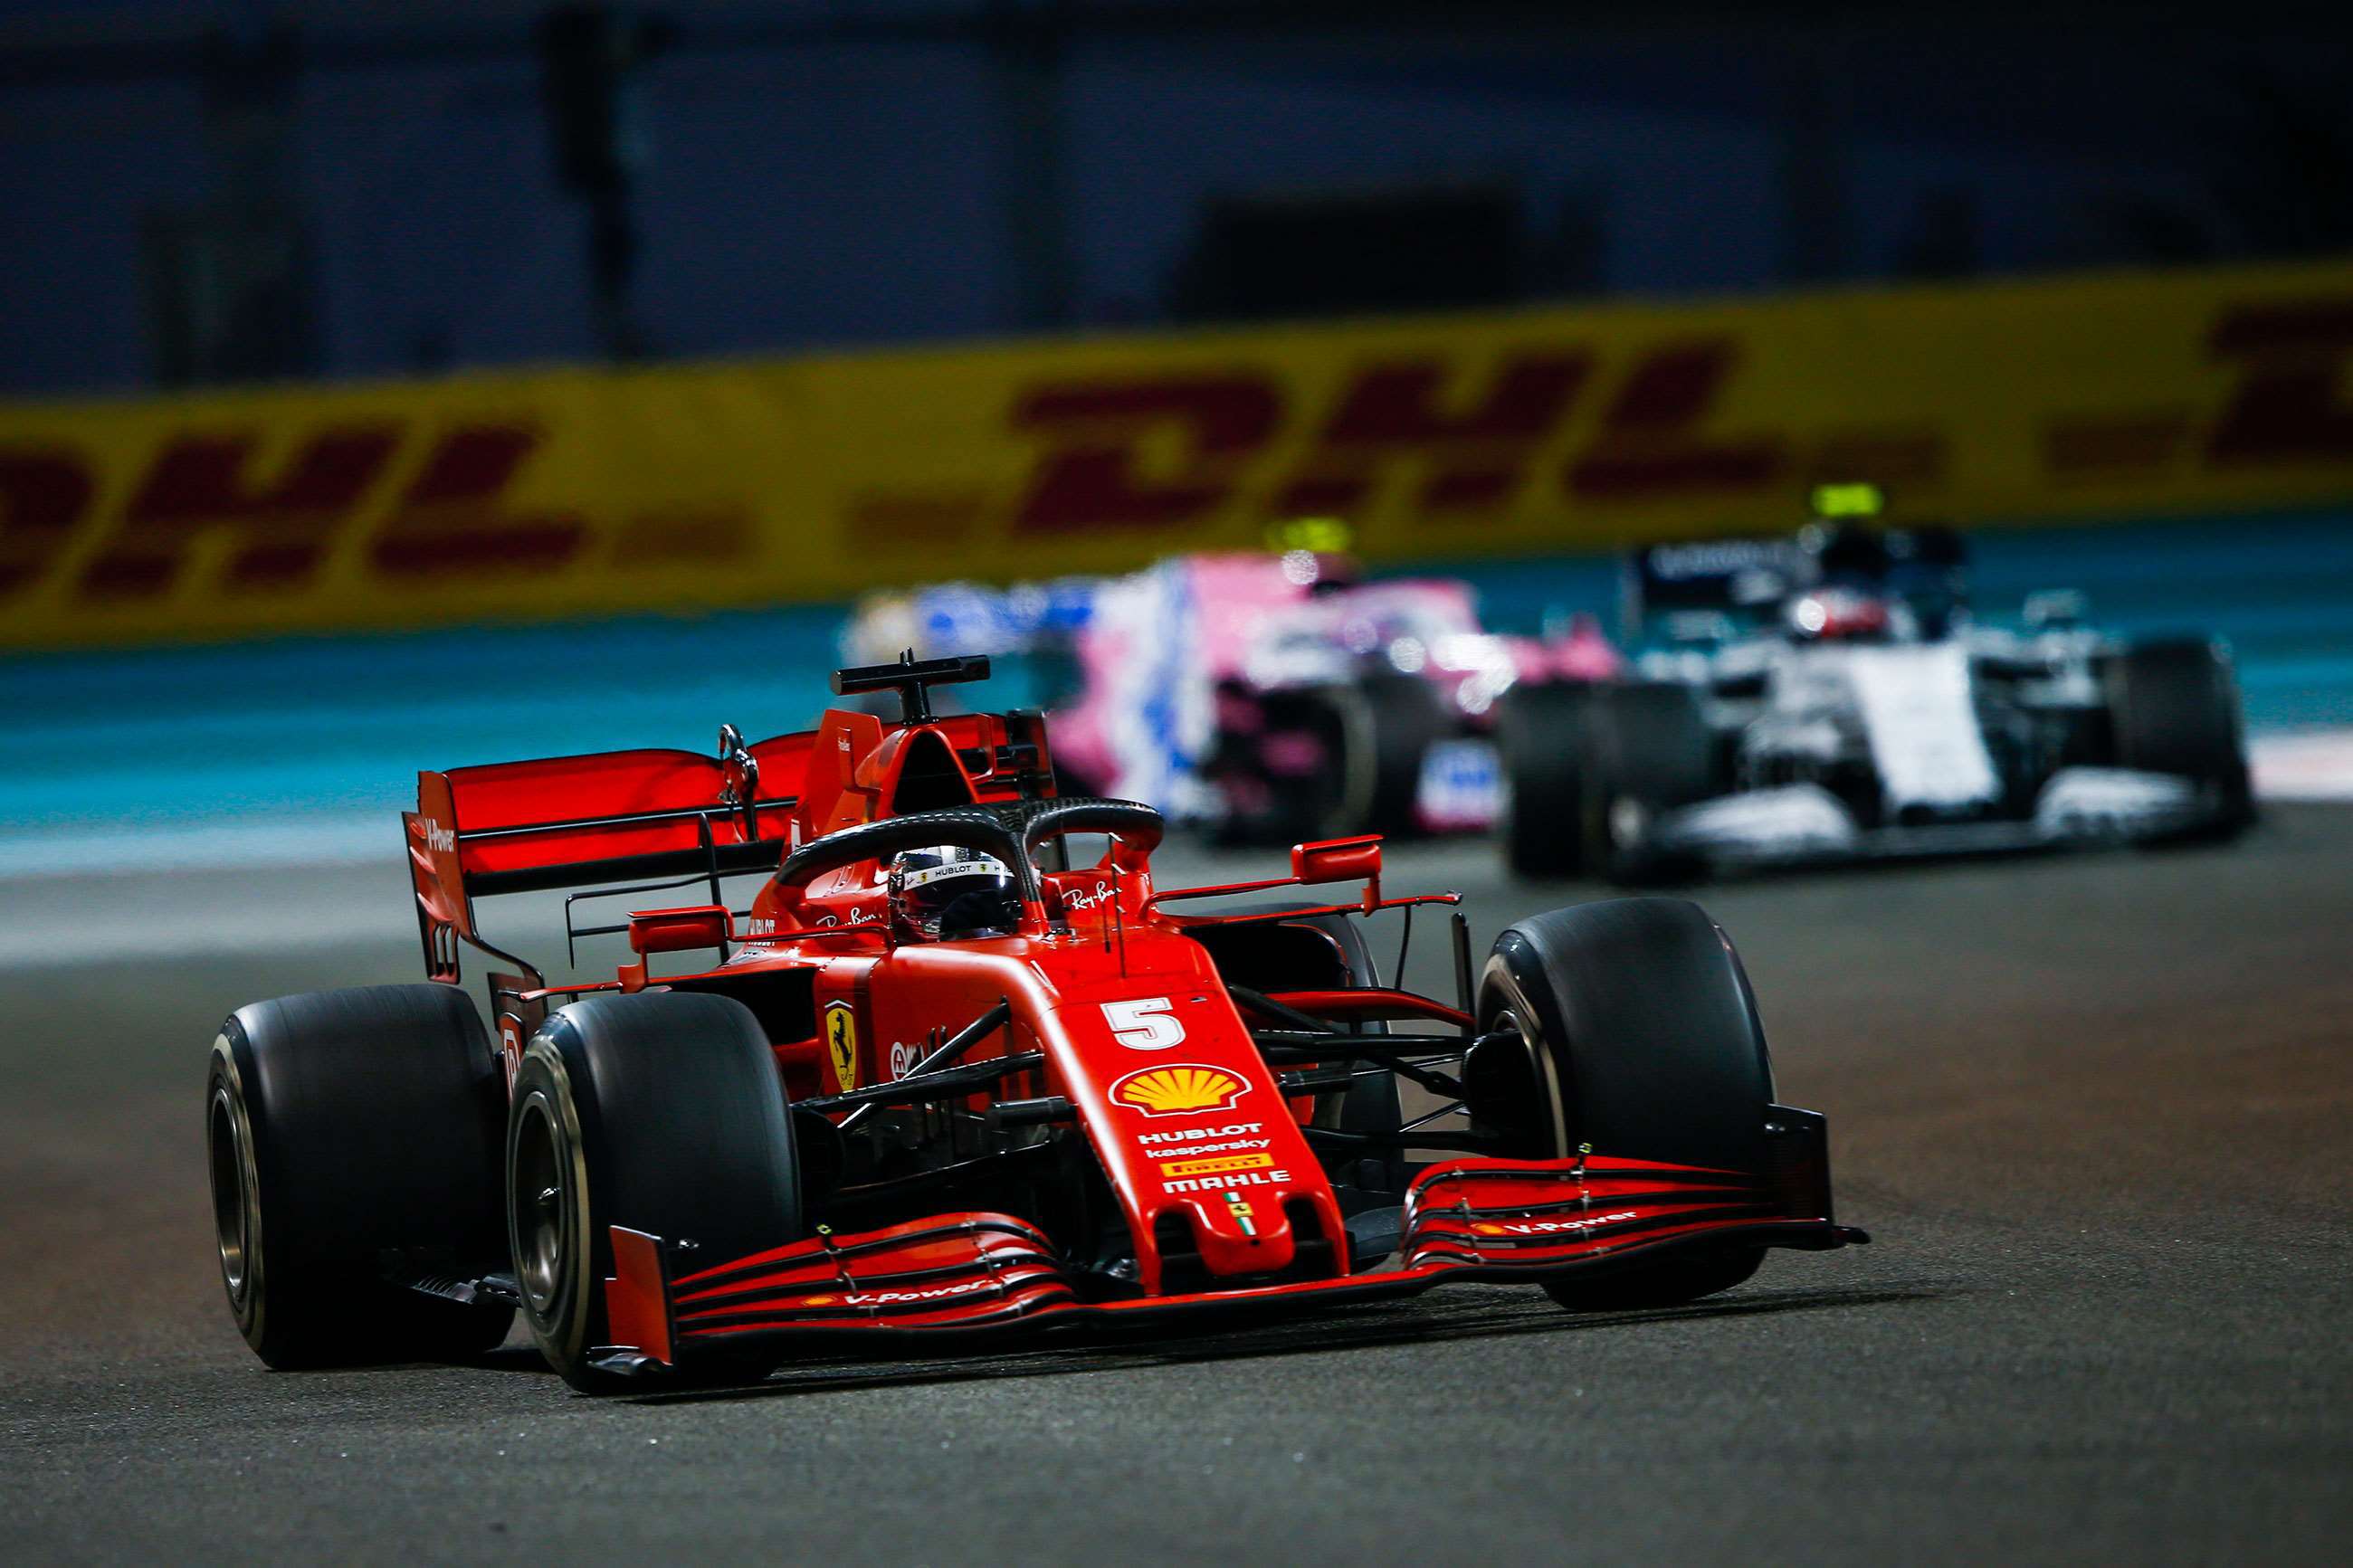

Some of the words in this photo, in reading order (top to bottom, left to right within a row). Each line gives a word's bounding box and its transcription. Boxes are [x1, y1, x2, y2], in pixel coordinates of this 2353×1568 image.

[1008, 338, 1794, 536] DHL
[935, 865, 972, 878] HUBLOT
[1100, 997, 1186, 1050] 5
[1138, 1123, 1262, 1144] HUBLOT
[1145, 1139, 1271, 1158] kaspersky
[1163, 1170, 1291, 1193] MAHLE
[1503, 1212, 1637, 1233] V-Power
[844, 1279, 987, 1304] V-Power
